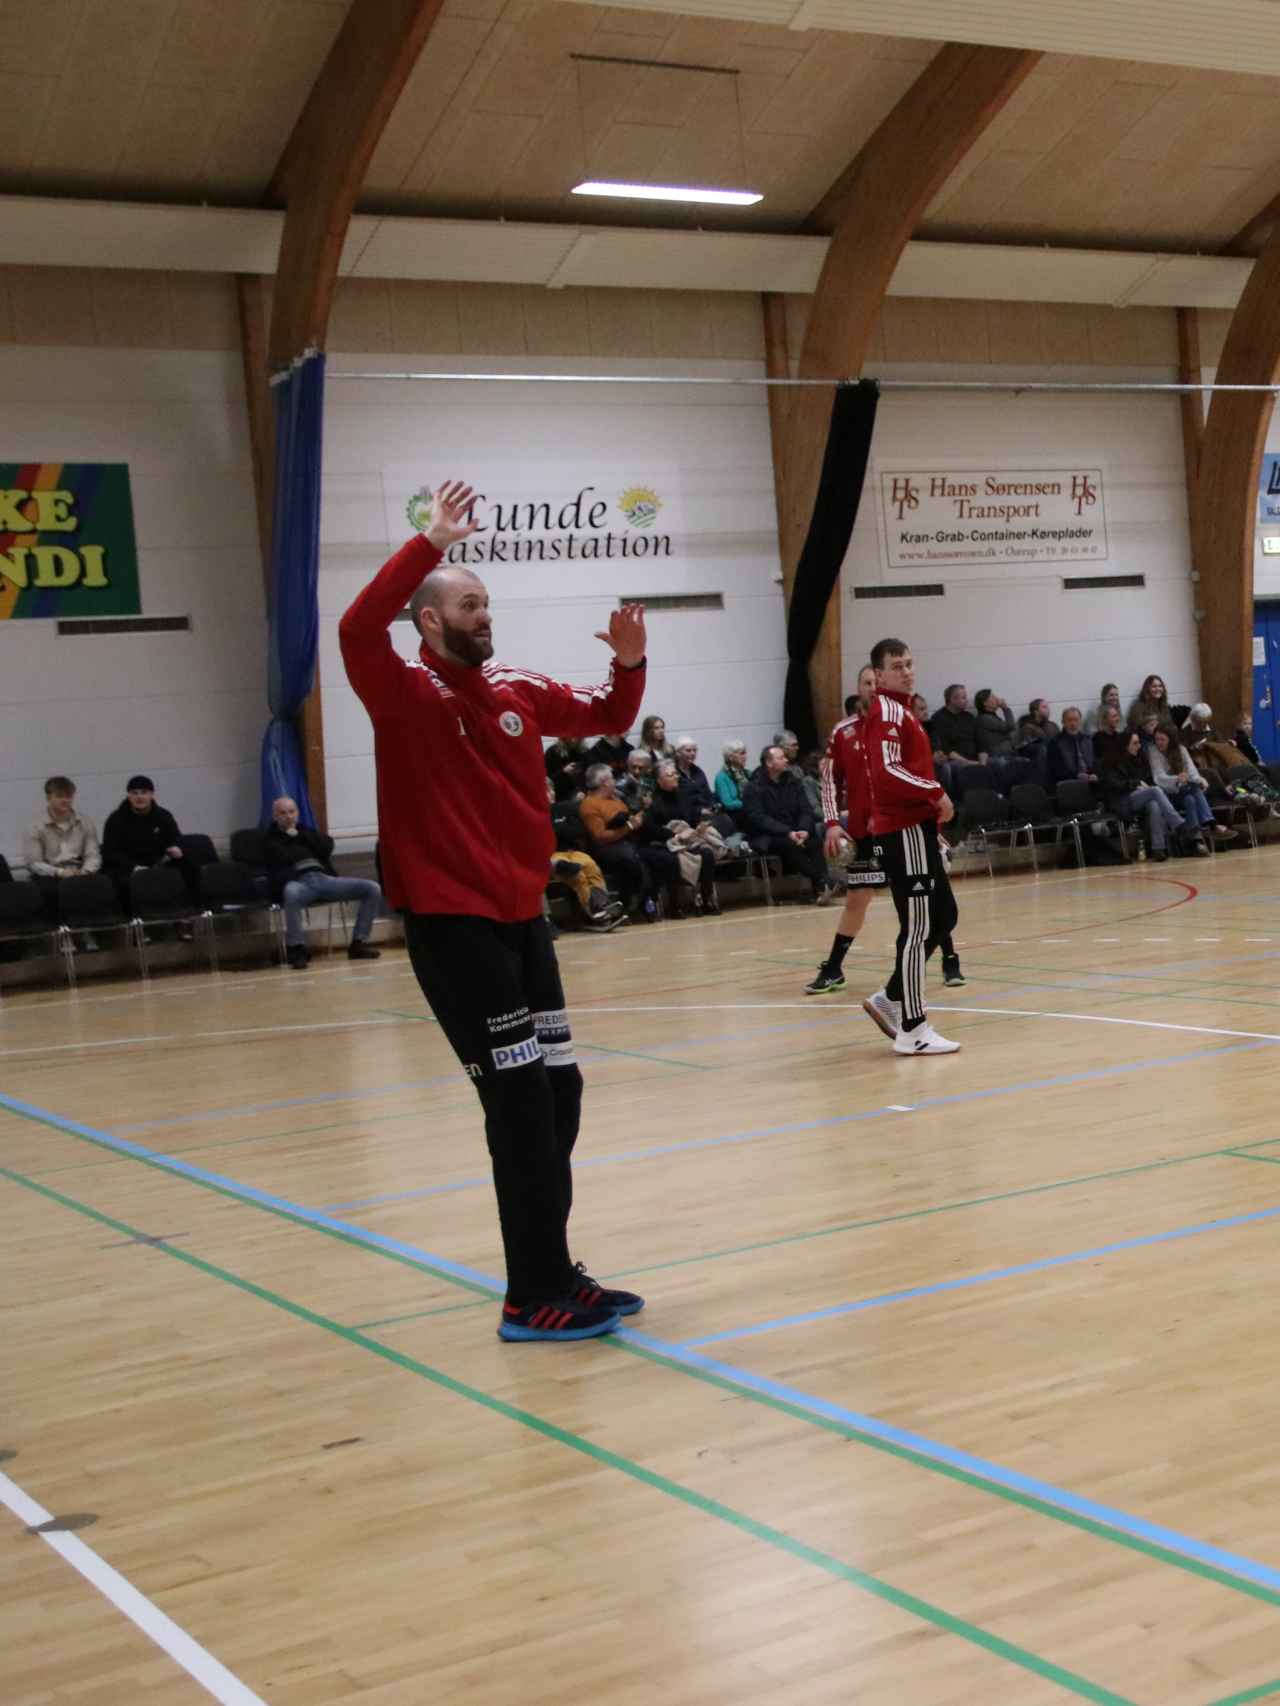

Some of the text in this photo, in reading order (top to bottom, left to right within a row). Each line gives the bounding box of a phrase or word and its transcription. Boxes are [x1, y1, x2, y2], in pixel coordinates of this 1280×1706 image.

[929, 476, 1061, 498] Hans Sørensen
[467, 486, 608, 532] Lunde
[953, 498, 1040, 523] Transport
[447, 530, 672, 565] askinstation
